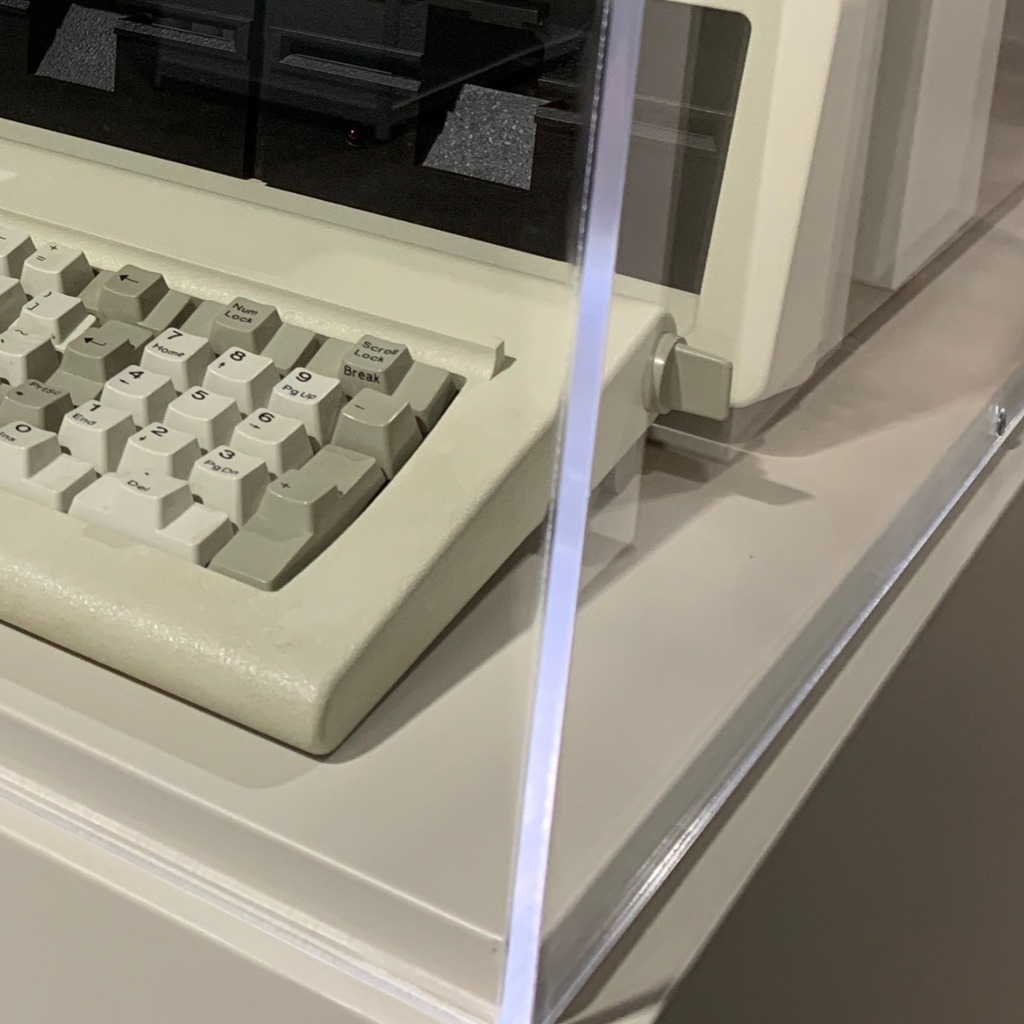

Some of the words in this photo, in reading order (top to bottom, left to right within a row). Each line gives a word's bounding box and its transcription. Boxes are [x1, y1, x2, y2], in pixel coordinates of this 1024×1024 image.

[232, 302, 258, 316] Num
[224, 310, 253, 325] Lock
[167, 330, 183, 340] 7
[152, 342, 185, 358] Home
[361, 340, 399, 356] Scroll
[230, 350, 246, 362] 8
[353, 349, 384, 364] Lock
[129, 370, 145, 379] 4
[296, 371, 312, 383] 9
[343, 364, 381, 384] Break
[191, 389, 209, 401] 5
[89, 403, 101, 413] 1
[72, 413, 97, 426] End
[258, 412, 275, 423] 6
[150, 426, 169, 437] 2
[219, 449, 235, 460] 3
[127, 479, 150, 492] Del
